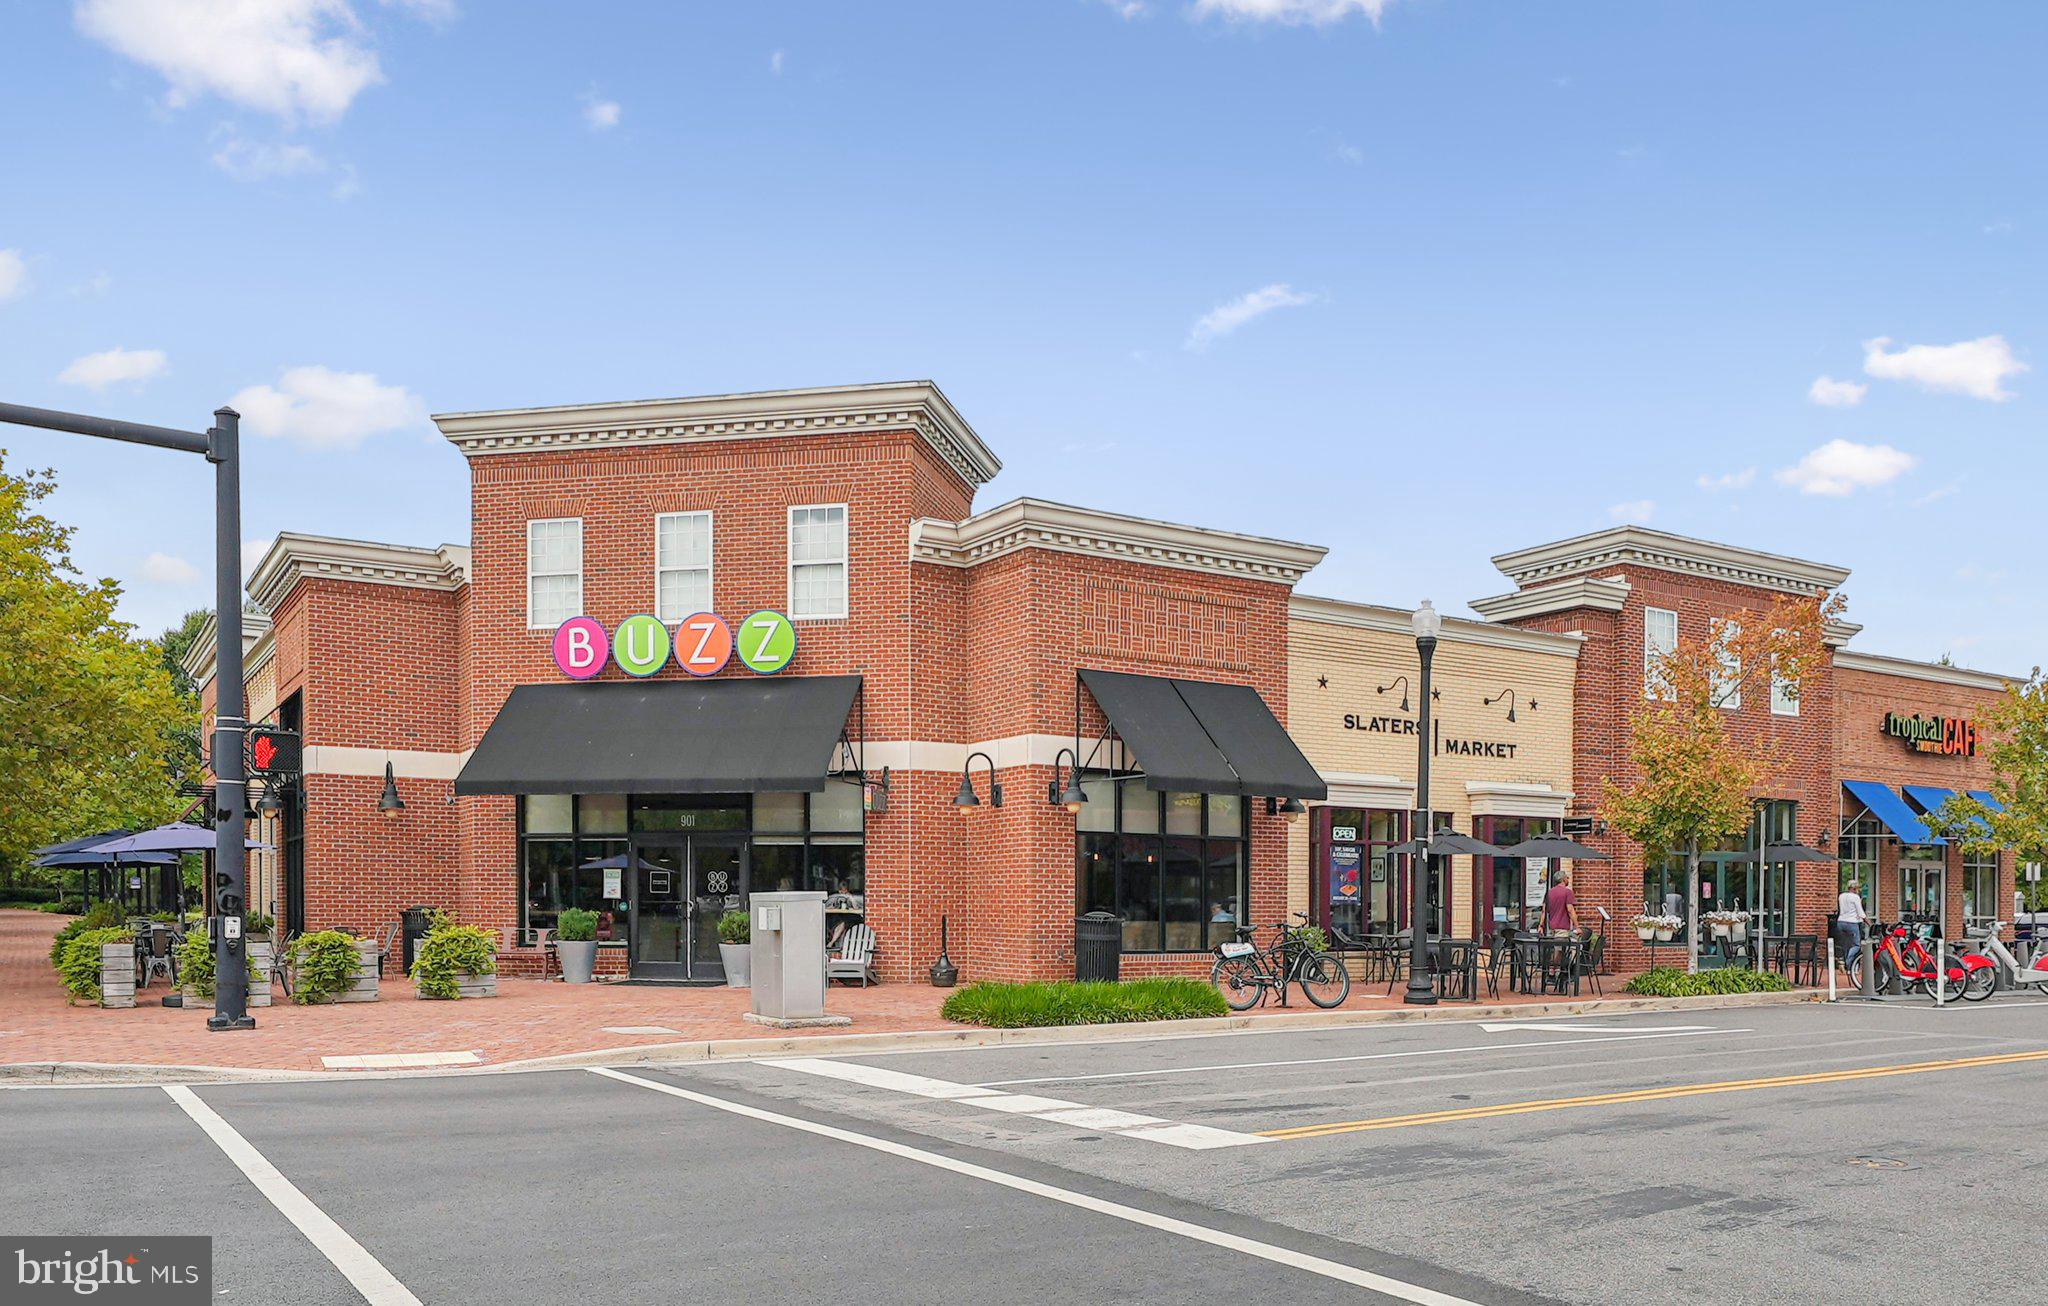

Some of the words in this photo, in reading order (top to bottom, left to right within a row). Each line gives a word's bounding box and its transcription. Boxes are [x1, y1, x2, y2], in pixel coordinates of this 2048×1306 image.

[567, 619, 781, 669] BUZZ
[1889, 712, 1942, 743] tropical
[1445, 739, 1517, 758] MARKET
[680, 814, 695, 828] 901
[1333, 829, 1356, 839] OPEN
